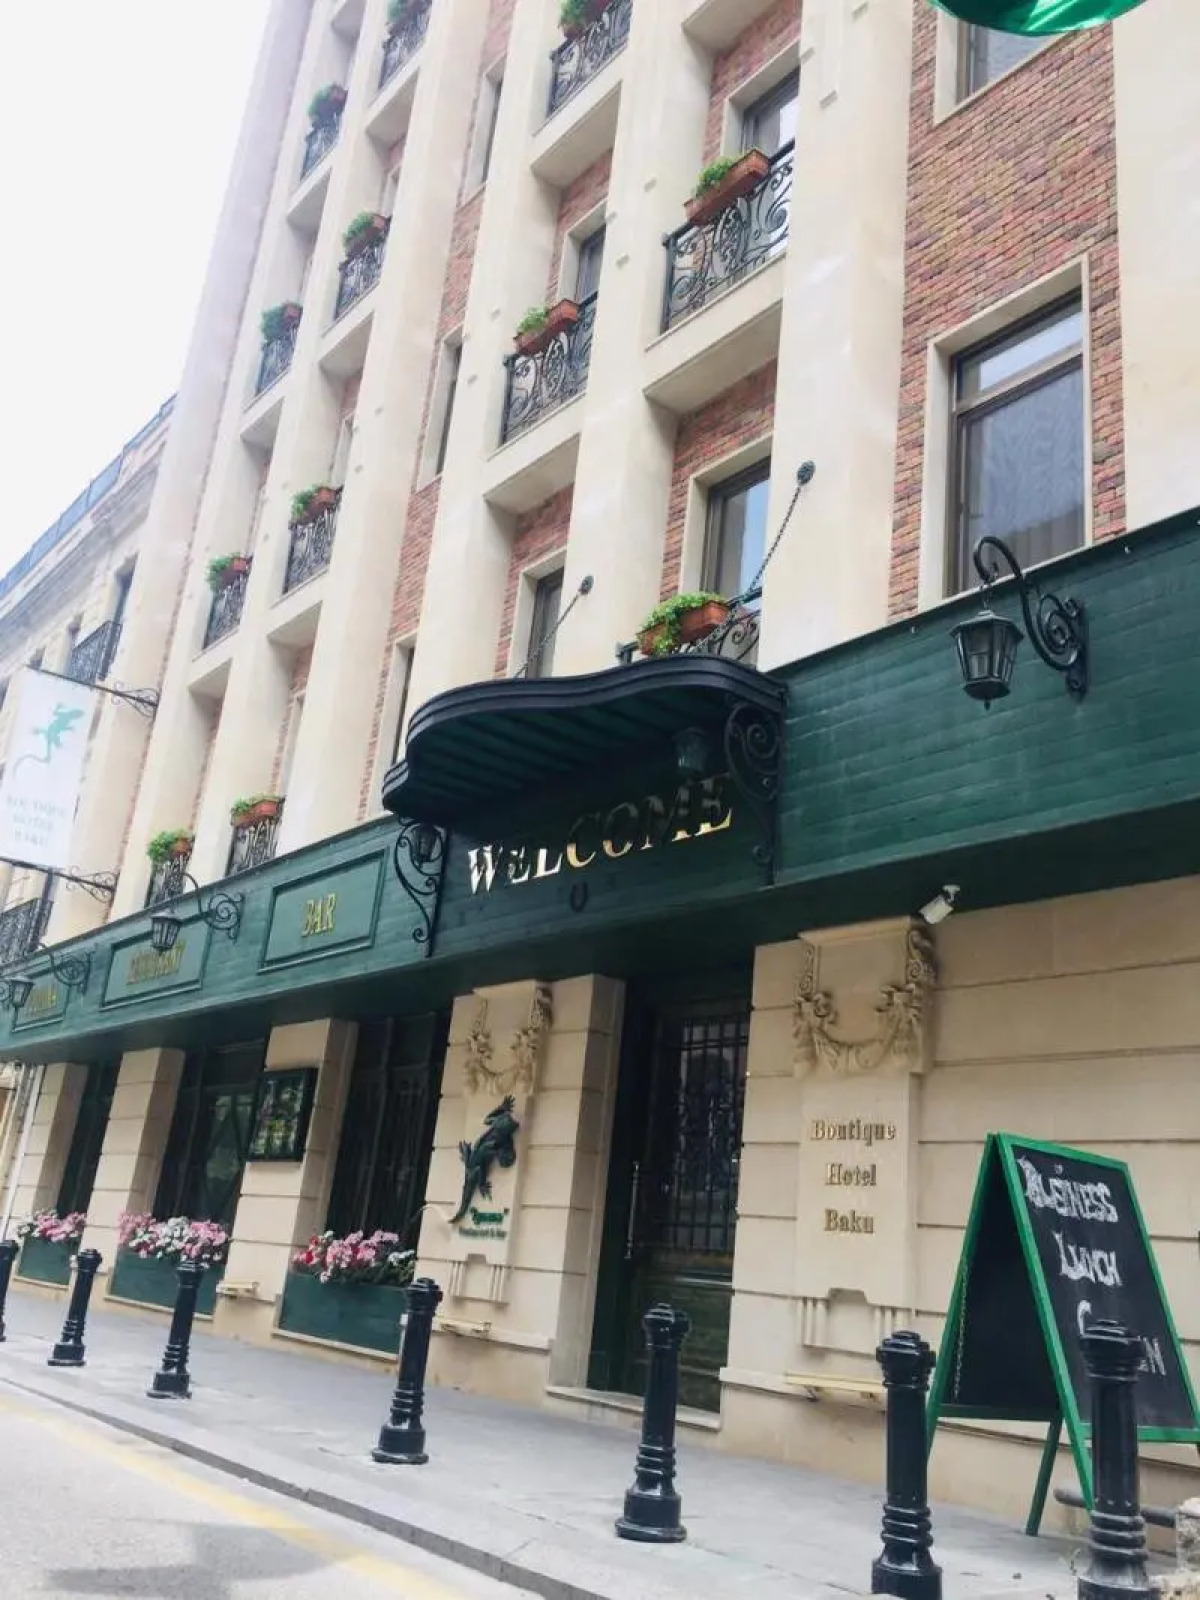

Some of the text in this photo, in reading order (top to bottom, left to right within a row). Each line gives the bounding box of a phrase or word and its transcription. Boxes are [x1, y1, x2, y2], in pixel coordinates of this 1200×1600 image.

[468, 773, 733, 895] WELCOME
[301, 893, 337, 938] BAR
[809, 1118, 896, 1147] Boutique
[824, 1162, 877, 1187] Hotel
[824, 1208, 874, 1234] Baku
